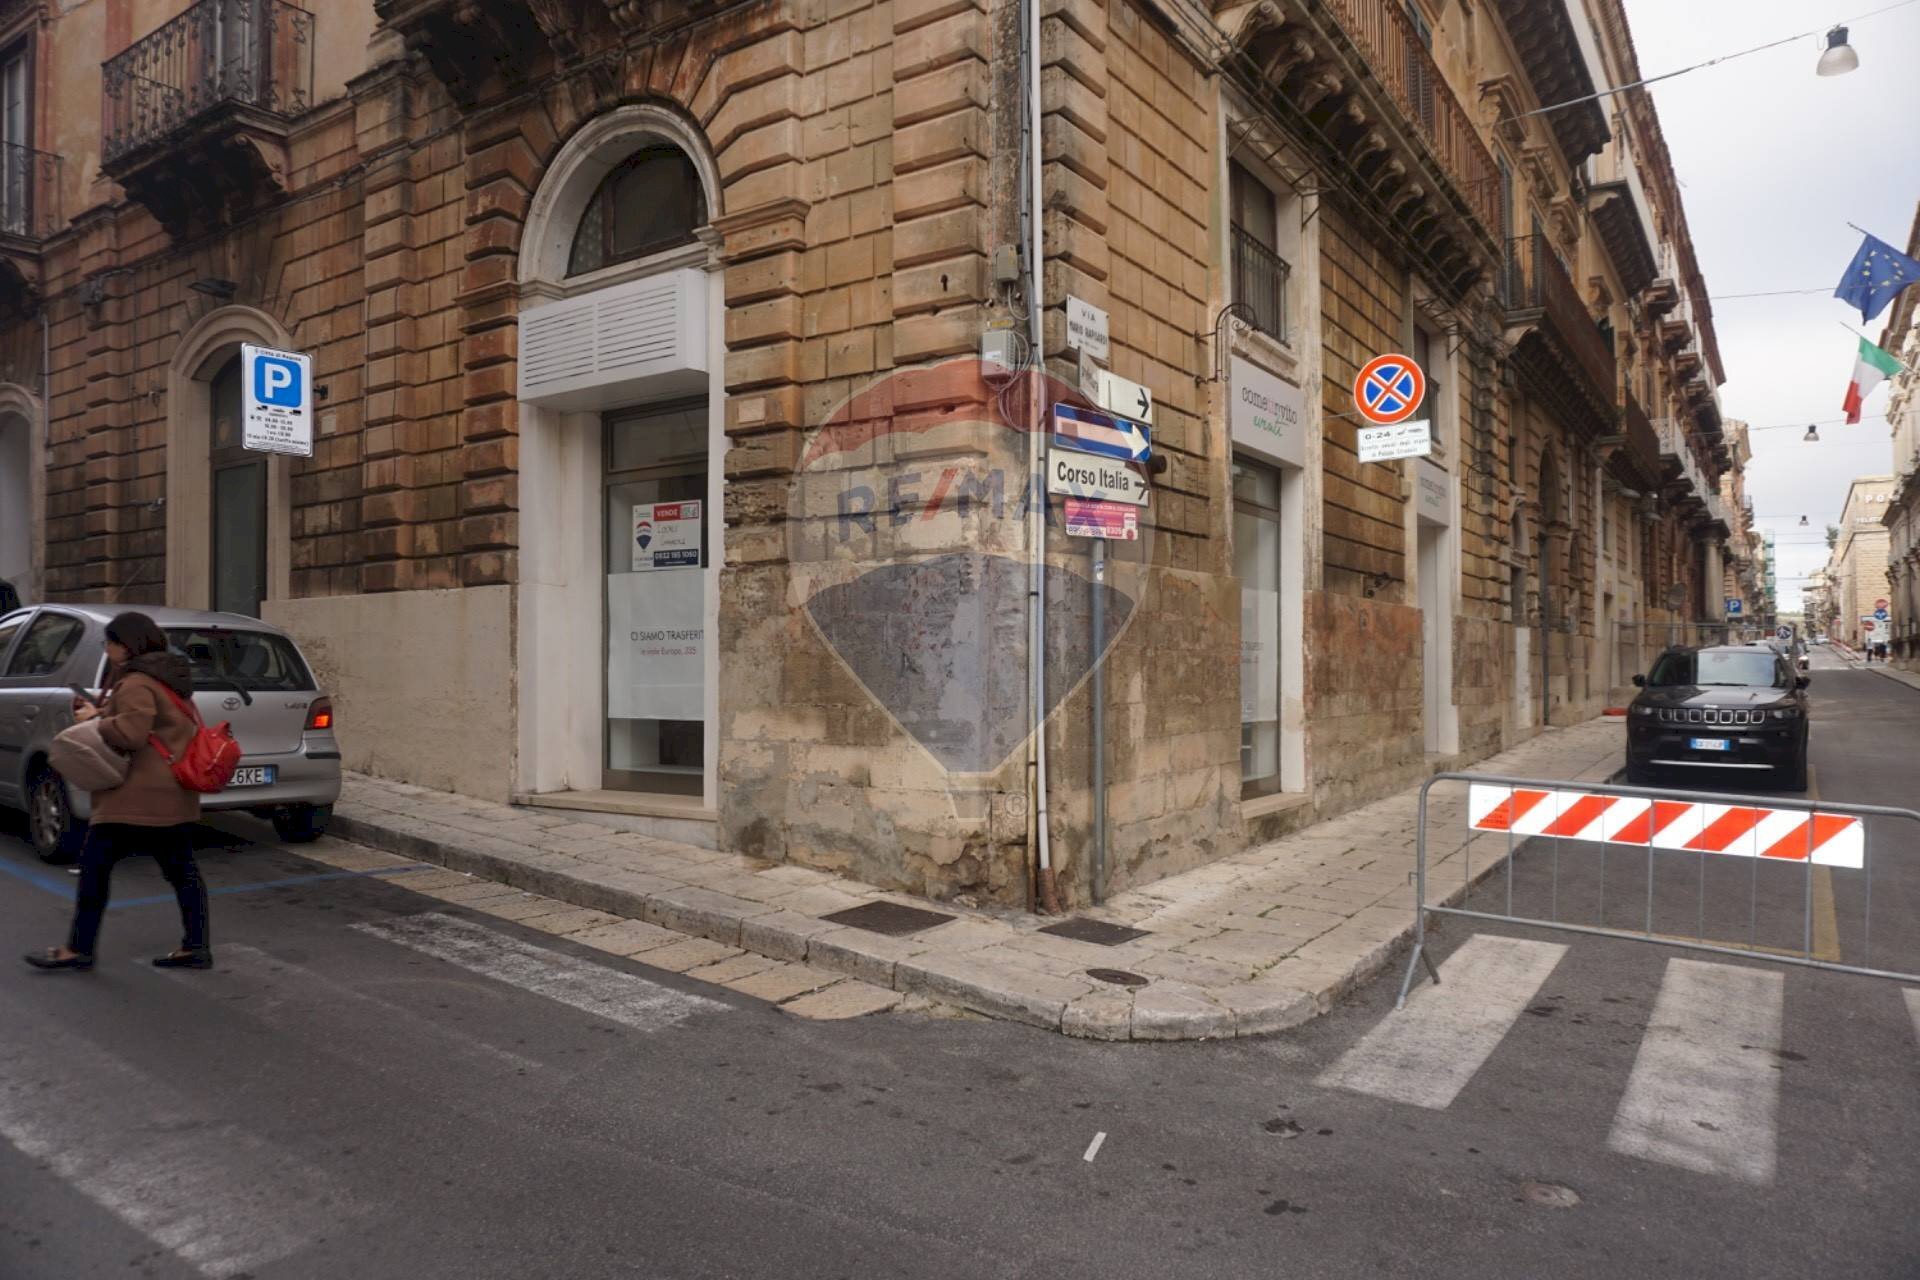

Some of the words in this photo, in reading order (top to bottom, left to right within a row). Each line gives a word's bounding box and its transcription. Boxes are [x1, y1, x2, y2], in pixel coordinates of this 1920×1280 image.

[1081, 309, 1096, 321] VIA
[264, 362, 292, 399] P
[1057, 461, 1096, 485] Corso
[1099, 468, 1129, 491] Italia
[656, 509, 678, 517] VENDE
[1729, 600, 1740, 612] P
[640, 631, 665, 641] SIAMO
